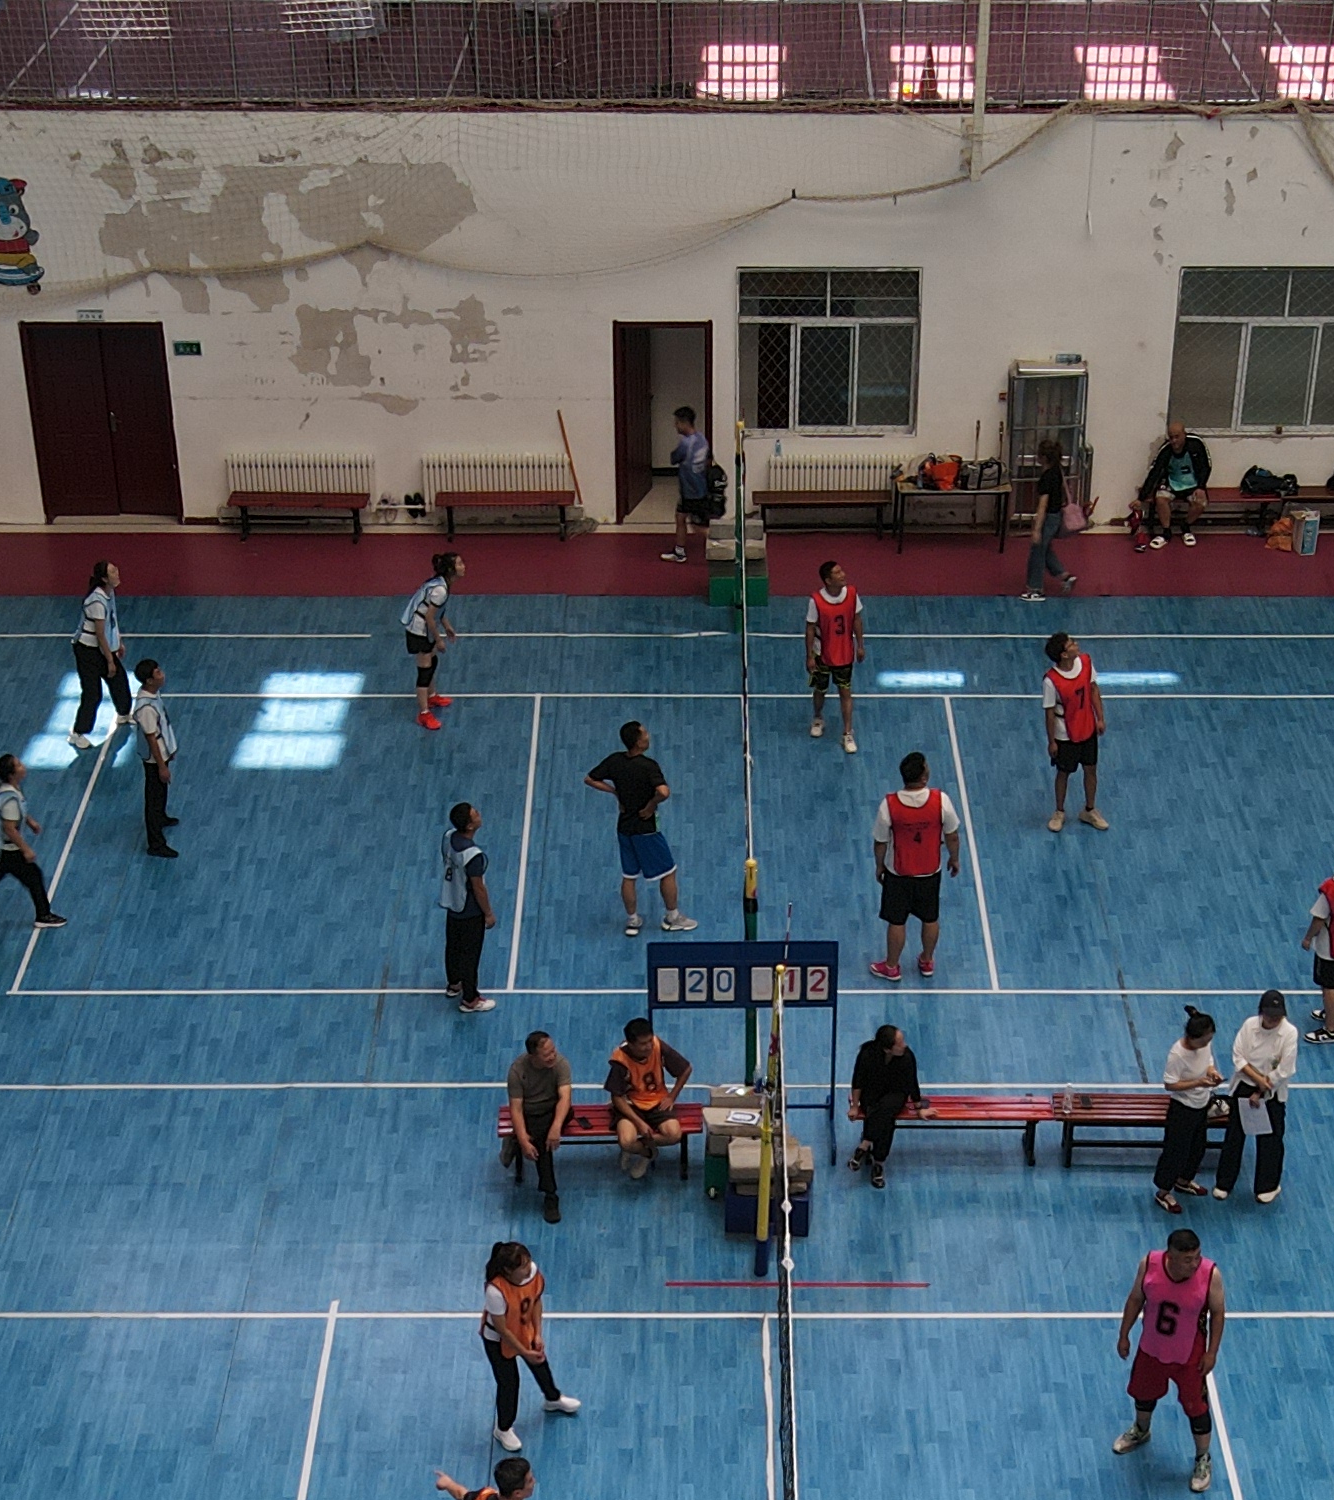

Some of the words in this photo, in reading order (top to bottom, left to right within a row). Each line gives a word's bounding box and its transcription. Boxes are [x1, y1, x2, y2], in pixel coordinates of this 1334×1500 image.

[835, 615, 845, 634] 3
[1074, 686, 1085, 709] 7
[688, 970, 732, 993] 20
[1156, 1301, 1181, 1336] 6
